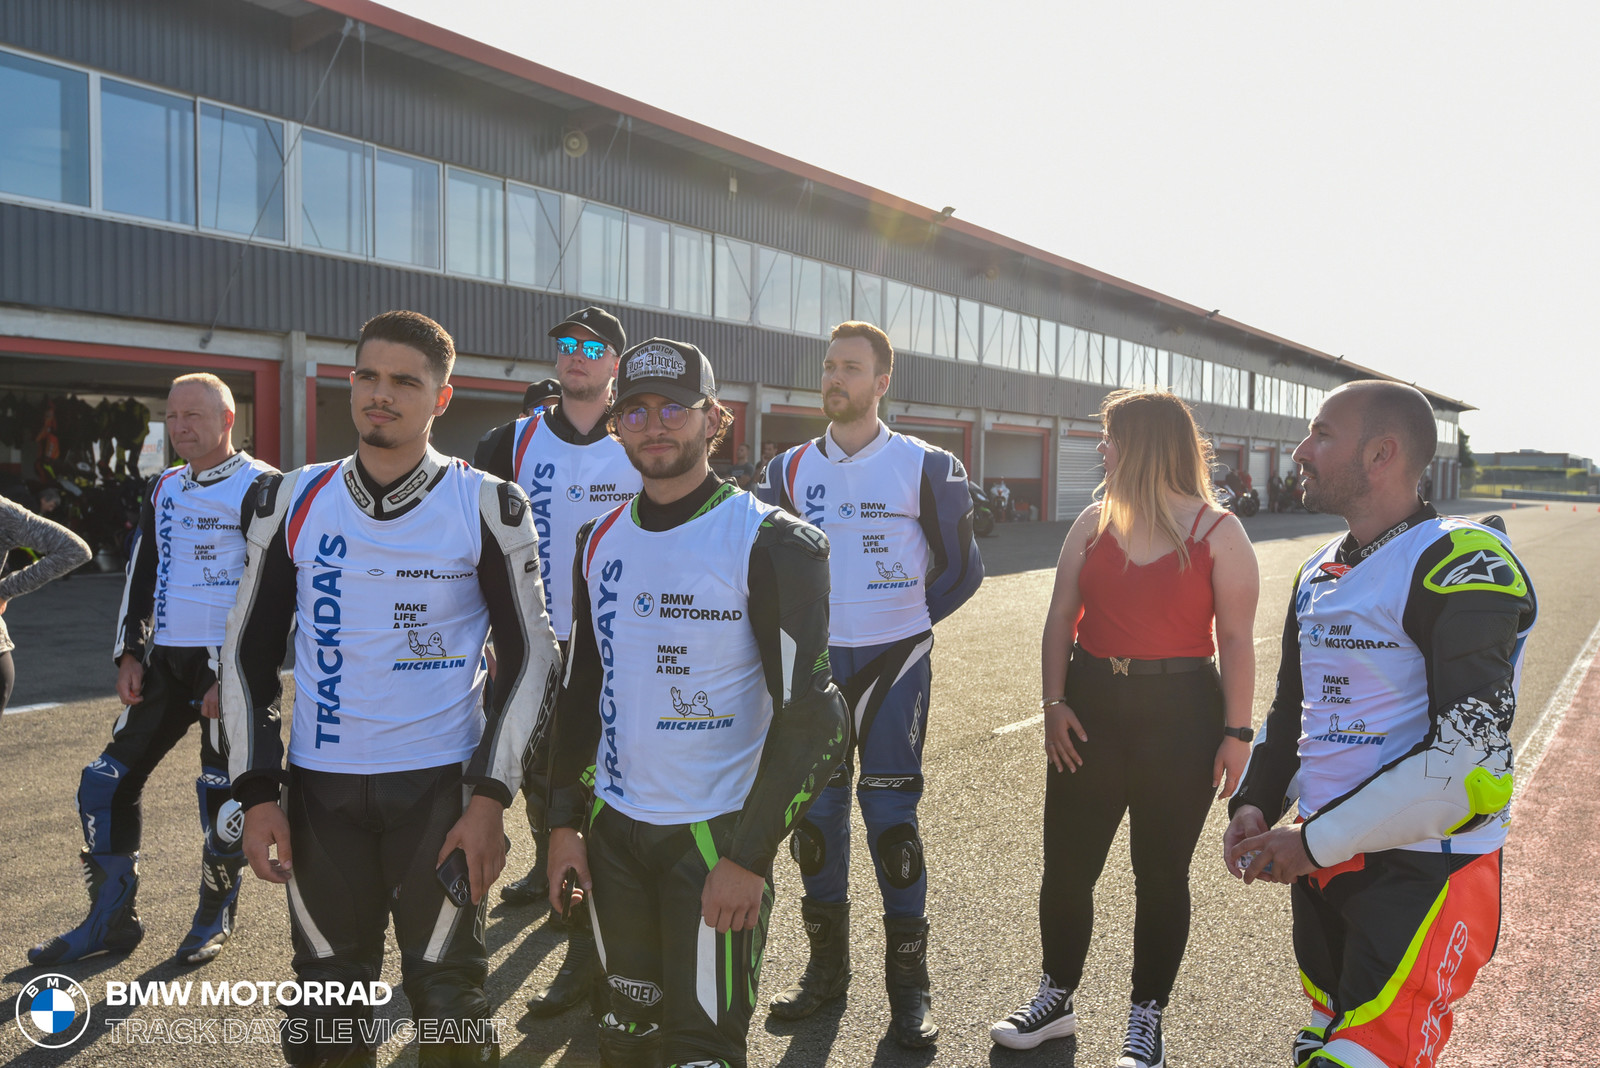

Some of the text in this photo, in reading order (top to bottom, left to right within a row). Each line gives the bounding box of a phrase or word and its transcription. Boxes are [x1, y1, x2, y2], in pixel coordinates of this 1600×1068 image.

[637, 345, 674, 356] VON DUTCH
[629, 353, 684, 373] Los Angeles
[207, 457, 241, 478] IXON
[589, 483, 617, 492] BMW
[589, 492, 640, 502] MOTORR
[860, 502, 886, 510] BMW
[197, 517, 220, 525] BMW
[196, 523, 241, 531] MOTORRA
[866, 579, 919, 590] MICHELIN
[660, 593, 694, 606] BMW
[394, 602, 427, 612] MAKE
[393, 612, 417, 621] LIFE
[659, 607, 743, 621] MOTORRAD
[1328, 625, 1352, 636] BMW
[312, 533, 347, 749] TRACKDAYS
[1325, 637, 1400, 650] MOTORRAD
[657, 645, 687, 655] MAKE
[392, 659, 467, 671] MICHELIN
[656, 655, 677, 664] LIFE
[656, 665, 690, 675] A RIDE
[1322, 674, 1350, 685] MAKE
[1322, 685, 1342, 695] LIFE
[655, 718, 734, 731] MICHELIN
